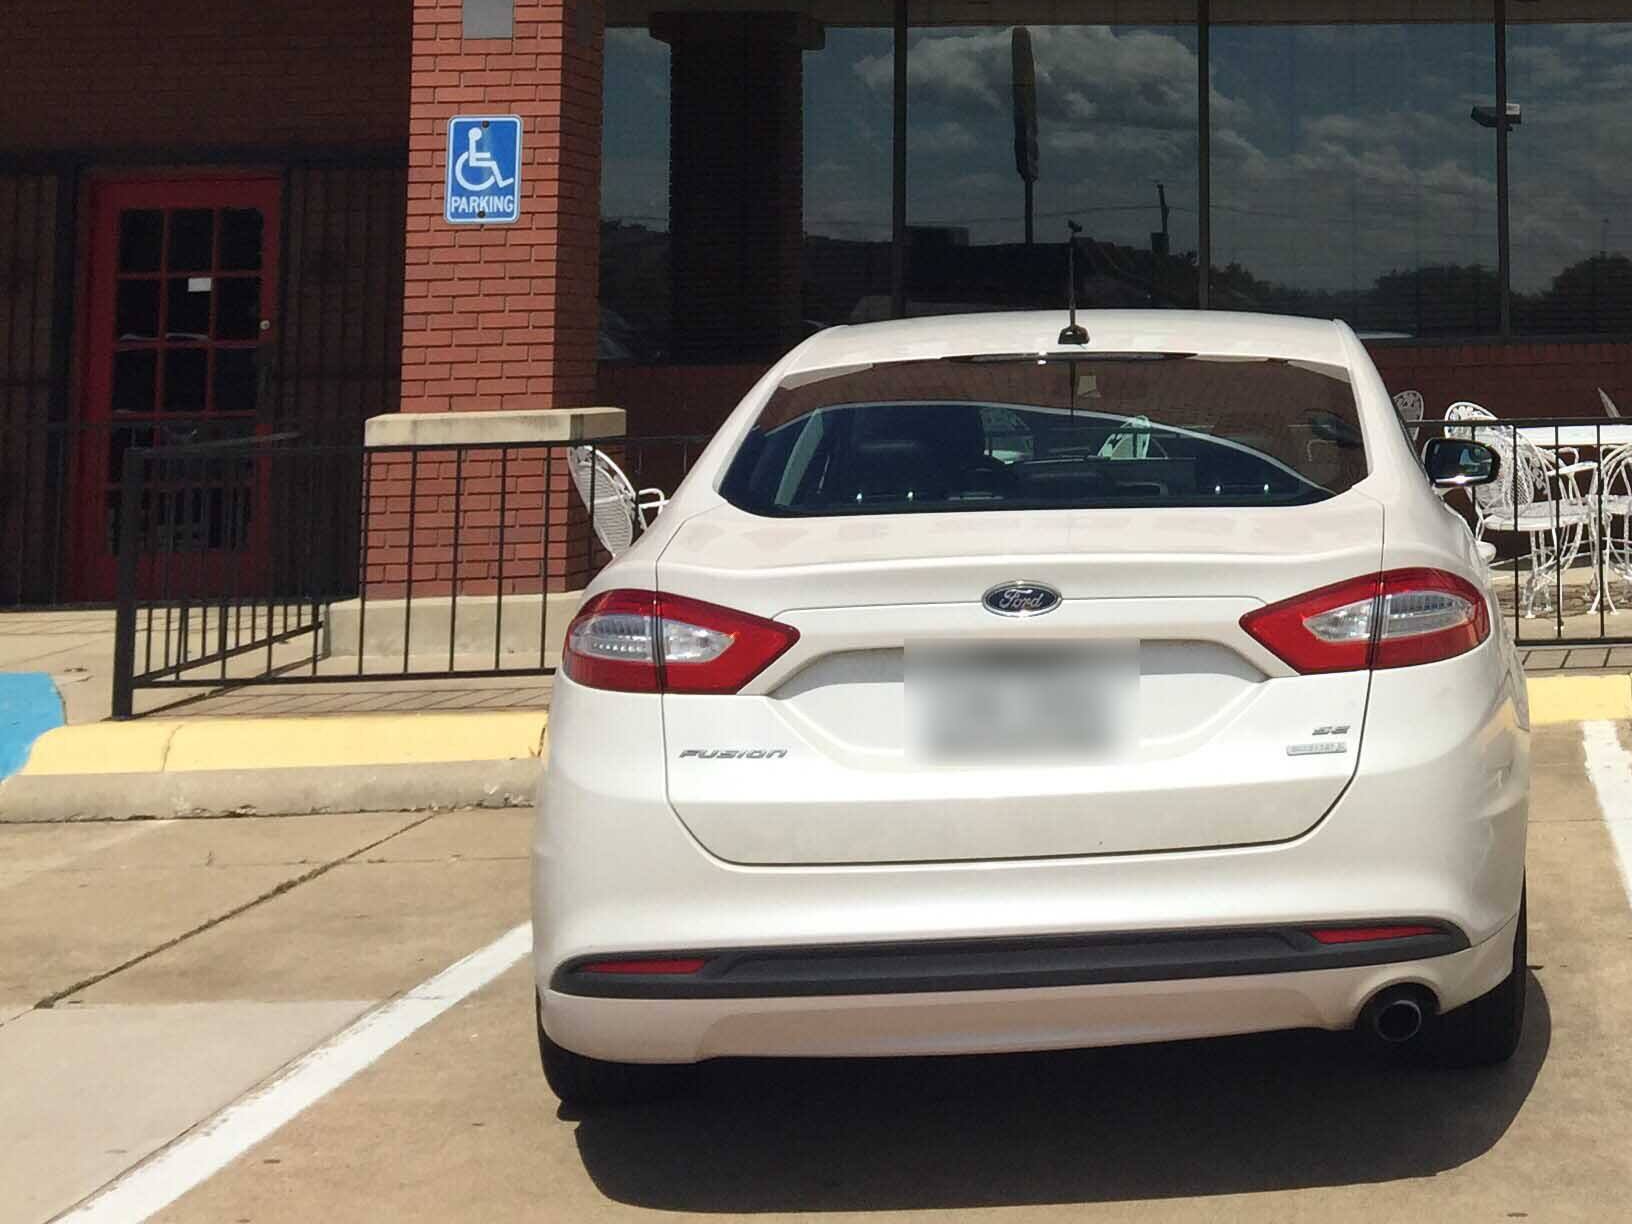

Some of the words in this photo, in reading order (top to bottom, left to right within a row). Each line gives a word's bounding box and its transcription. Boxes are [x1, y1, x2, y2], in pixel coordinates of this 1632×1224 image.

[451, 195, 514, 213] PARKING
[999, 588, 1044, 609] Ford
[679, 749, 788, 759] FUSION
